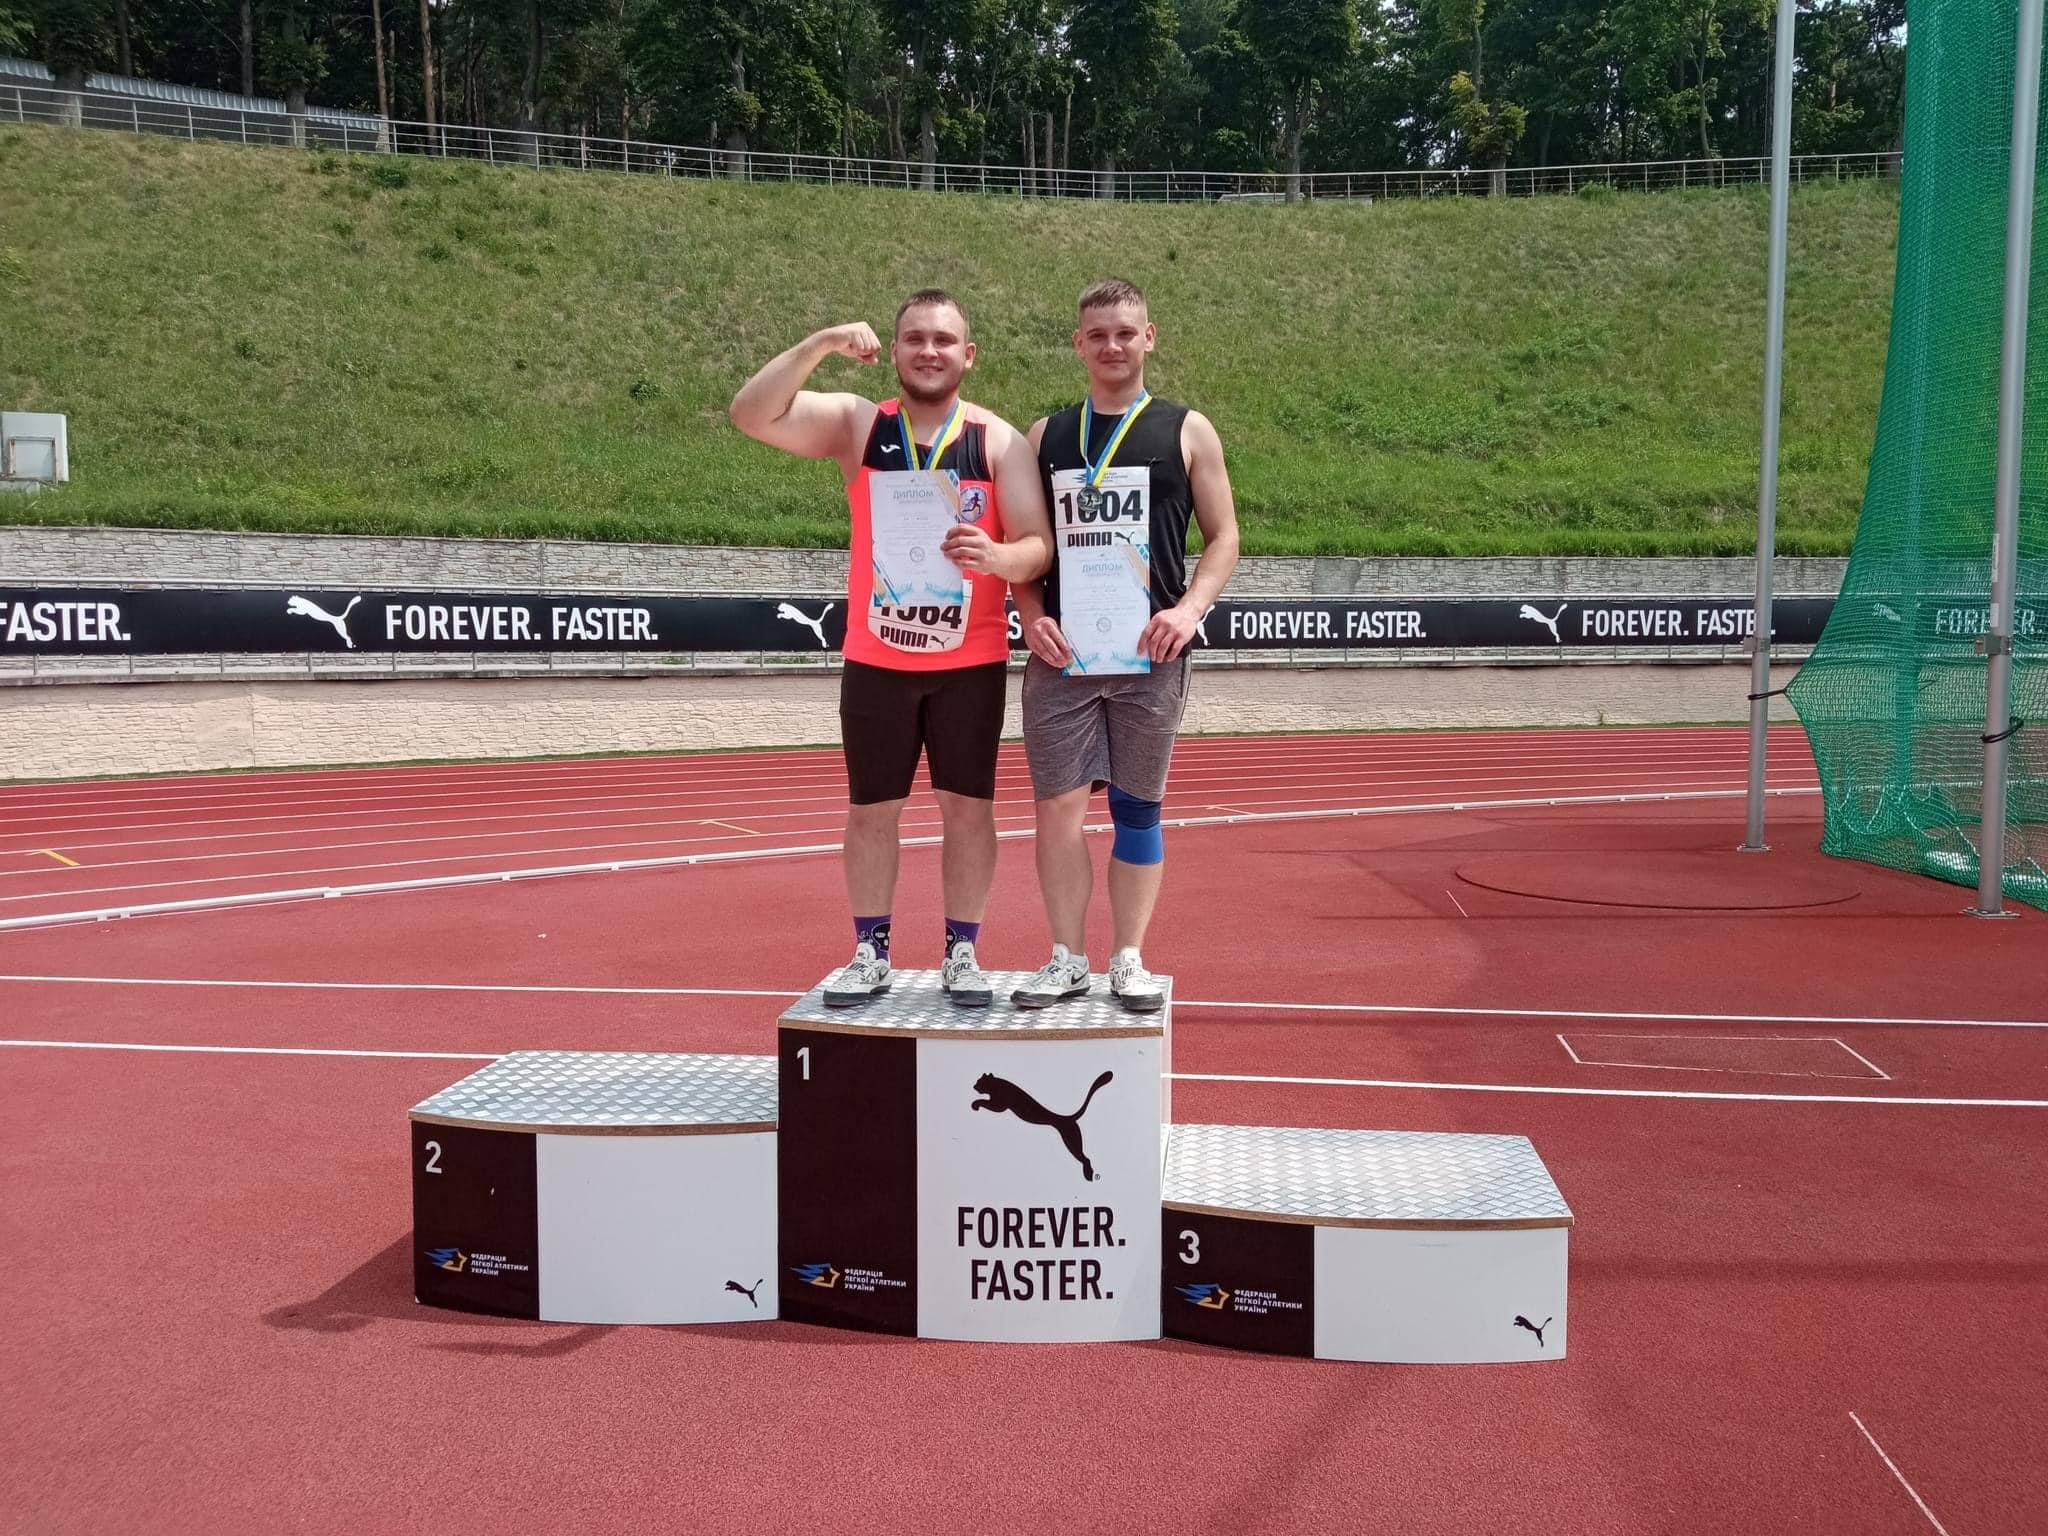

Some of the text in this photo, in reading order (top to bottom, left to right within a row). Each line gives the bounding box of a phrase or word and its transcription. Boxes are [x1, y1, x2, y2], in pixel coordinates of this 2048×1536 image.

[1067, 532, 1112, 547] PUMA
[385, 605, 658, 641] FOREVER. FASTER.
[880, 625, 929, 649] PUMA
[1230, 611, 1427, 640] FOREVER. FASTER.
[1581, 609, 1776, 637] FOREVER. FASTE.
[797, 1047, 810, 1080] 1
[425, 1141, 442, 1174] 2
[958, 1206, 1126, 1248] FOREVER.
[1179, 1230, 1200, 1264] 3
[845, 1268, 883, 1278] ФЕДЕРАЦІЯ
[870, 1278, 906, 1287] АТЛЕТИКИ
[971, 1259, 1114, 1301] FASTER.
[1234, 1289, 1277, 1299] ФЕДЕРАЦІЯ
[1262, 1300, 1303, 1309] АТЛЕТИКИ
